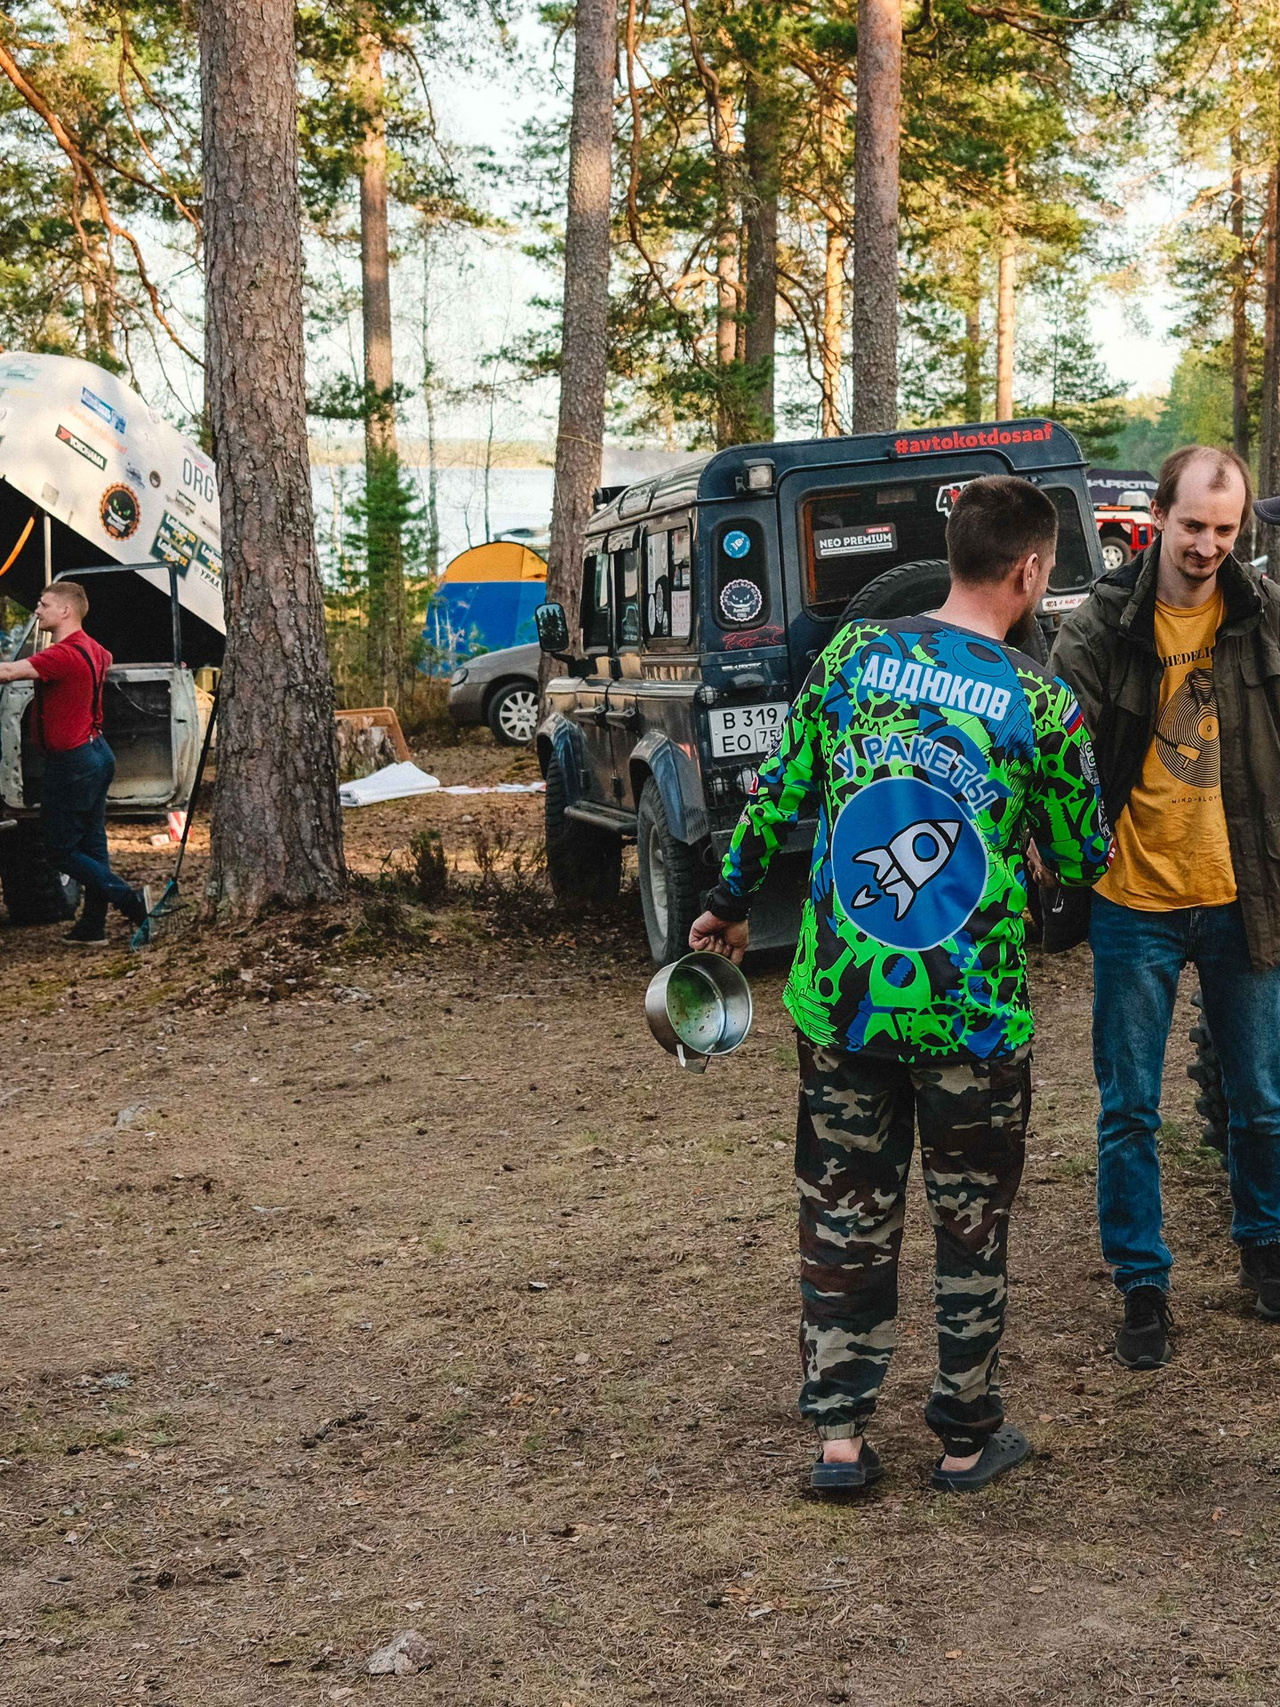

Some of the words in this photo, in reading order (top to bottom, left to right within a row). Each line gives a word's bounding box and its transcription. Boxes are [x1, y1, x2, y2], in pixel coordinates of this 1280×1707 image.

[895, 423, 1052, 453] #avtokotdosaaf
[183, 458, 214, 503] ORG
[820, 538, 841, 548] NEO
[844, 533, 892, 546] PREMIUM
[1163, 647, 1212, 667] HEDELI
[861, 655, 1012, 721] АВДЮКОВ
[742, 708, 777, 727] 319
[834, 746, 857, 780] У
[862, 733, 999, 814] РАКЕТЫ
